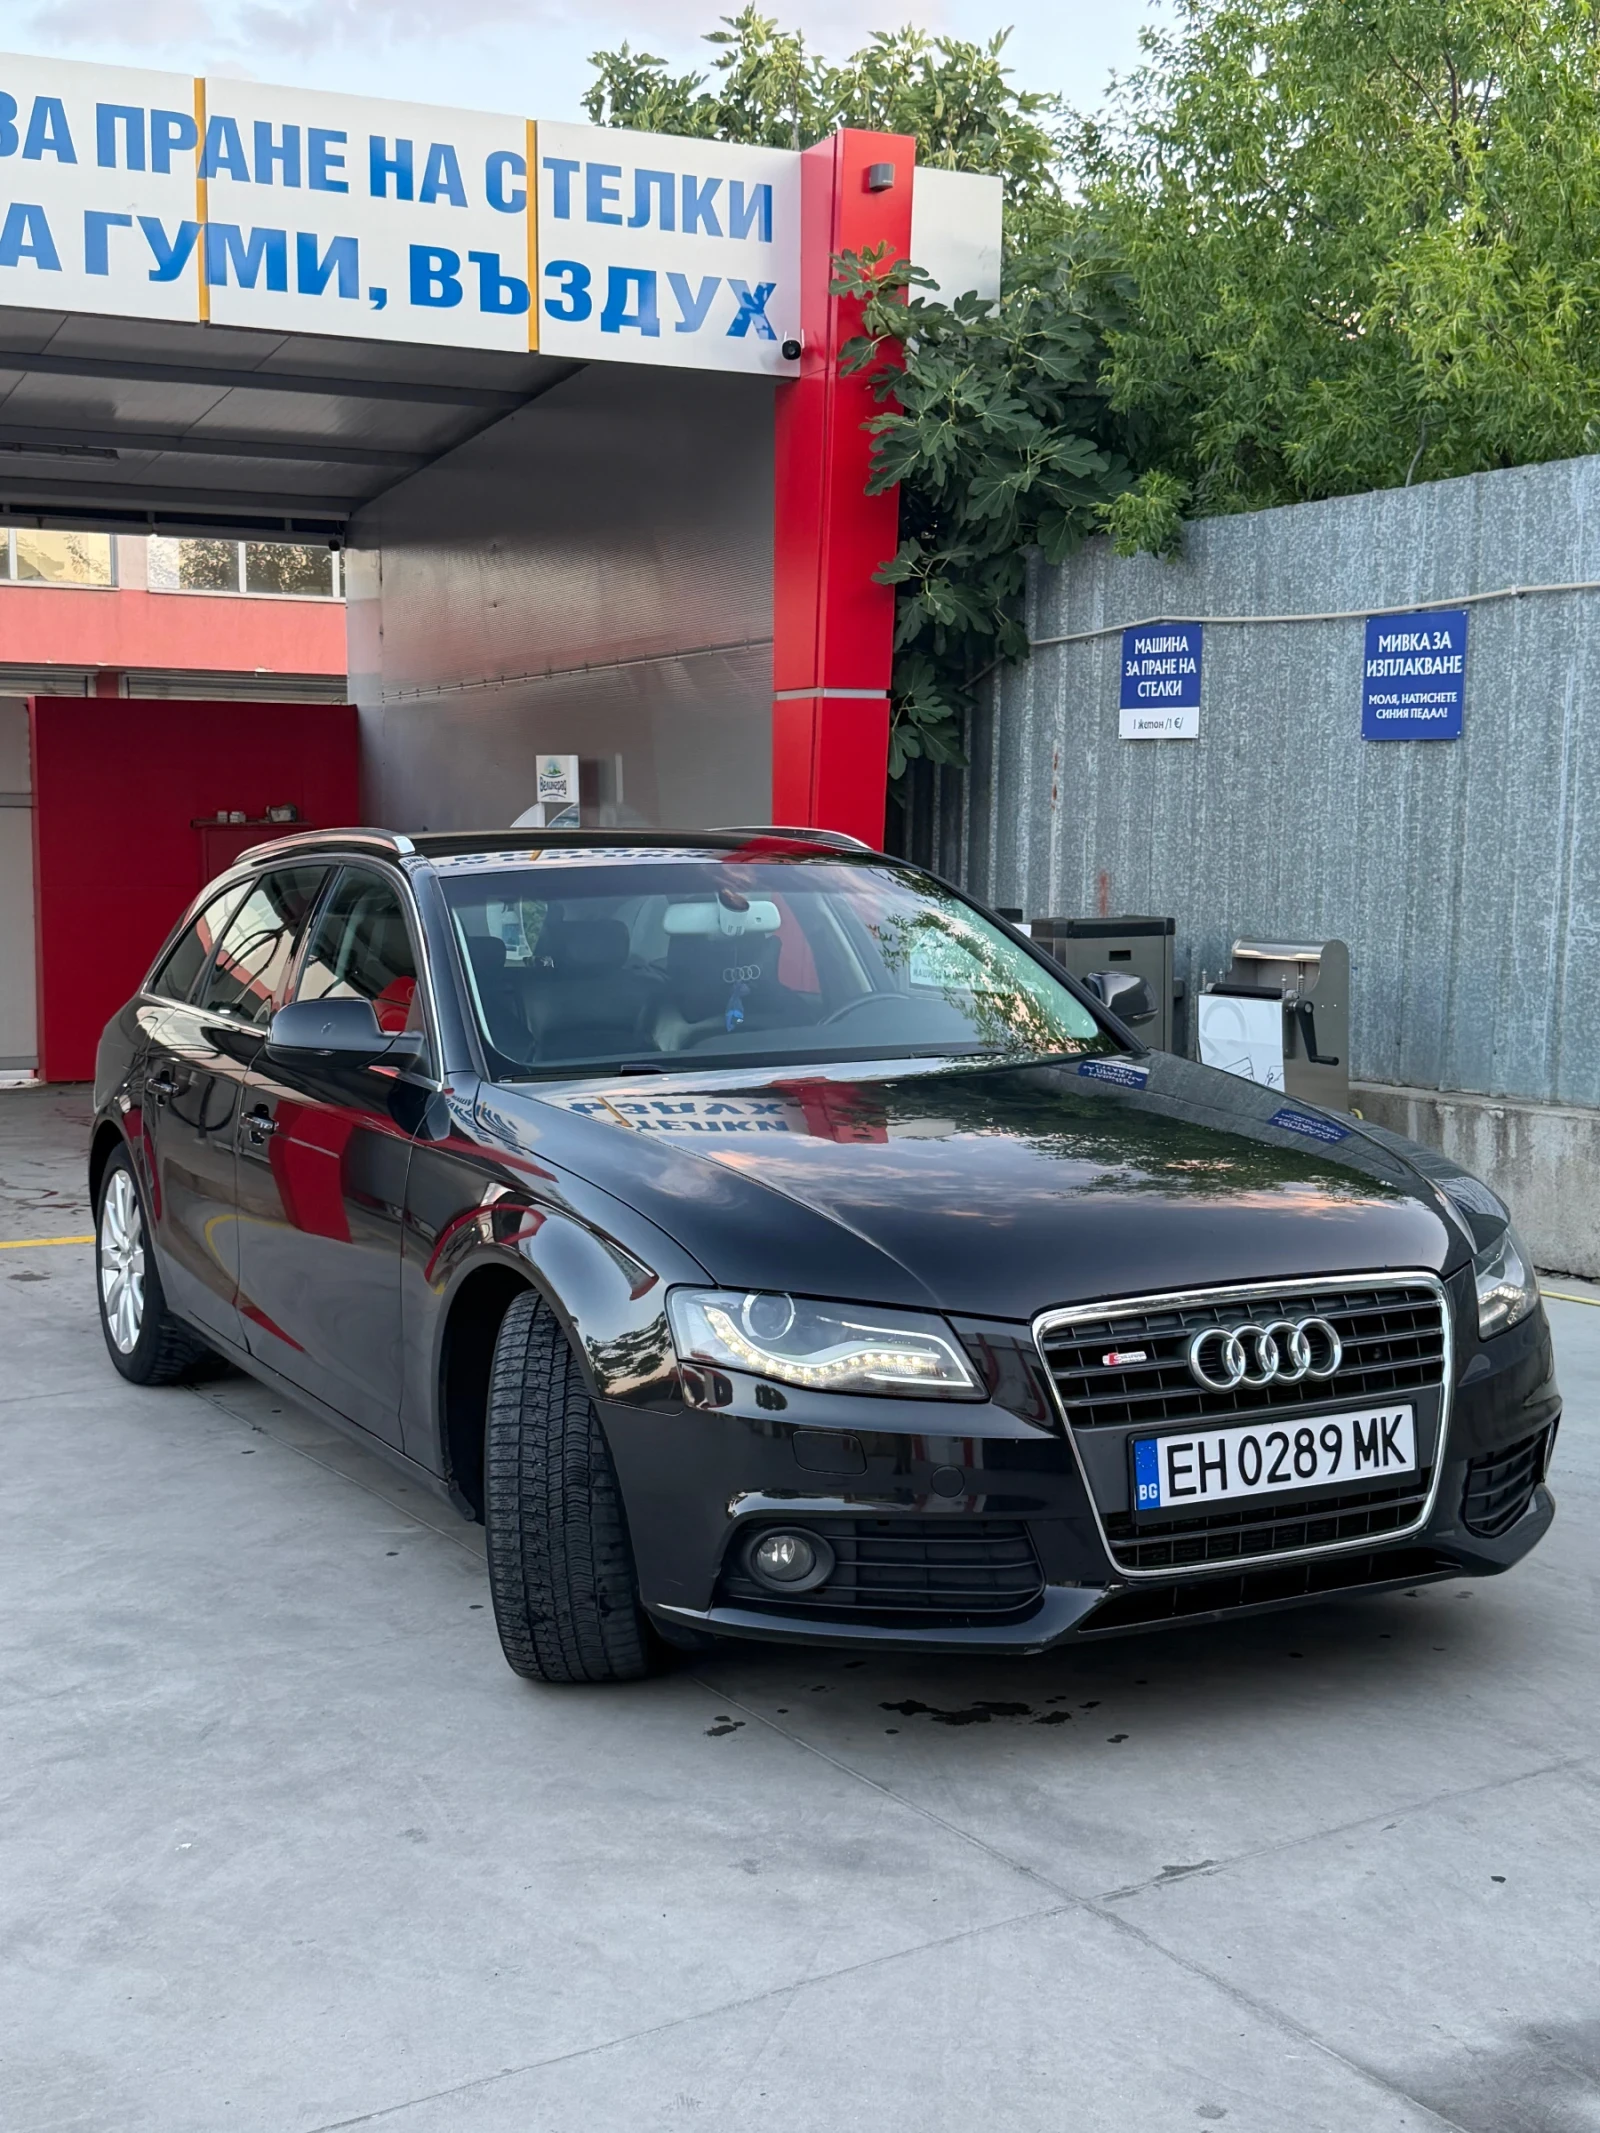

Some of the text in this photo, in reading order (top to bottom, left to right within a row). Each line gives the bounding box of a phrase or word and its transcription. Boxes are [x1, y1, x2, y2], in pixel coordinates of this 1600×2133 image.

[96, 103, 349, 194] ПРАНЕ
[369, 135, 468, 208] НА
[485, 150, 773, 243] СТЕЛКИ
[84, 210, 388, 310] ГУМИ,
[409, 244, 777, 340] ВЪЗДУХ
[1135, 636, 1189, 654] МАШИНА
[1378, 631, 1452, 653] МИВКА ЗА
[1125, 657, 1196, 676] ЗА ПРАНЕ НА
[1366, 655, 1463, 677] ИЗПЛАКВАНЕ
[1137, 680, 1182, 697] СТЕЛКИ
[1368, 692, 1457, 706] МОЛЯ, НАТИСНЕТЕ
[1376, 707, 1448, 720] СИНИЯ ПЕДАЛ!
[1167, 1414, 1406, 1498] EH 0289 MK
[1139, 1482, 1158, 1501] BG
